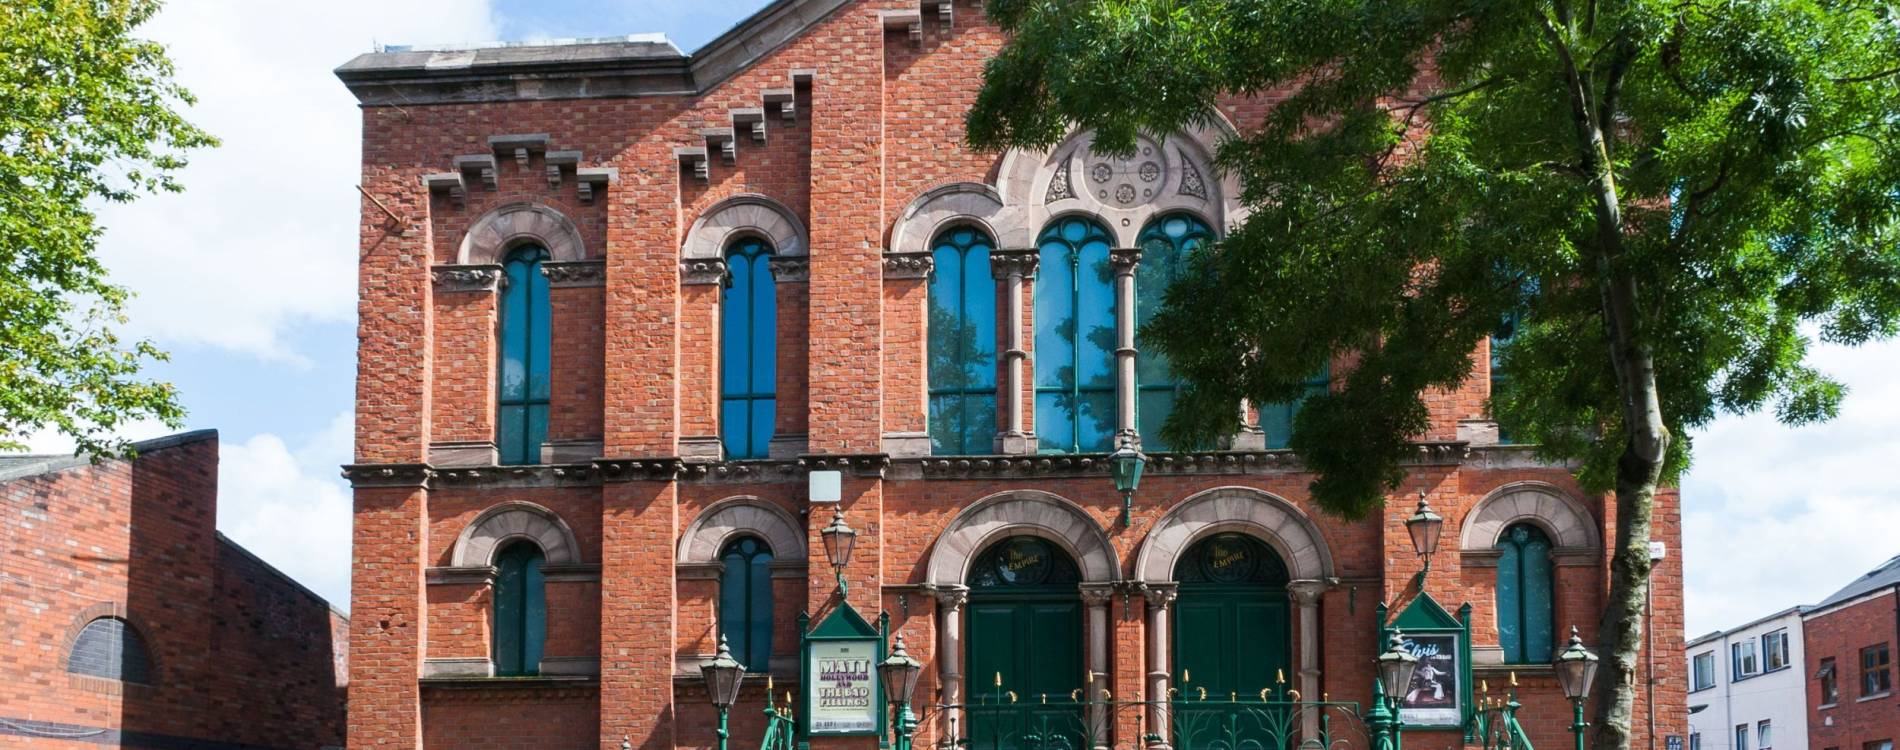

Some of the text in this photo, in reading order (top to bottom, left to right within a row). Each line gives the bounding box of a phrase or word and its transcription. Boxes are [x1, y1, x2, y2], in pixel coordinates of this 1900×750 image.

[1008, 554, 1040, 571] EMPIRE
[1213, 551, 1245, 568] EMPIRE
[1402, 639, 1439, 657] Elvis
[820, 660, 869, 673] MATT
[820, 673, 869, 681] HOLLYWOOD
[820, 688, 869, 698] THE BAD
[820, 697, 869, 707] FEELINGS
